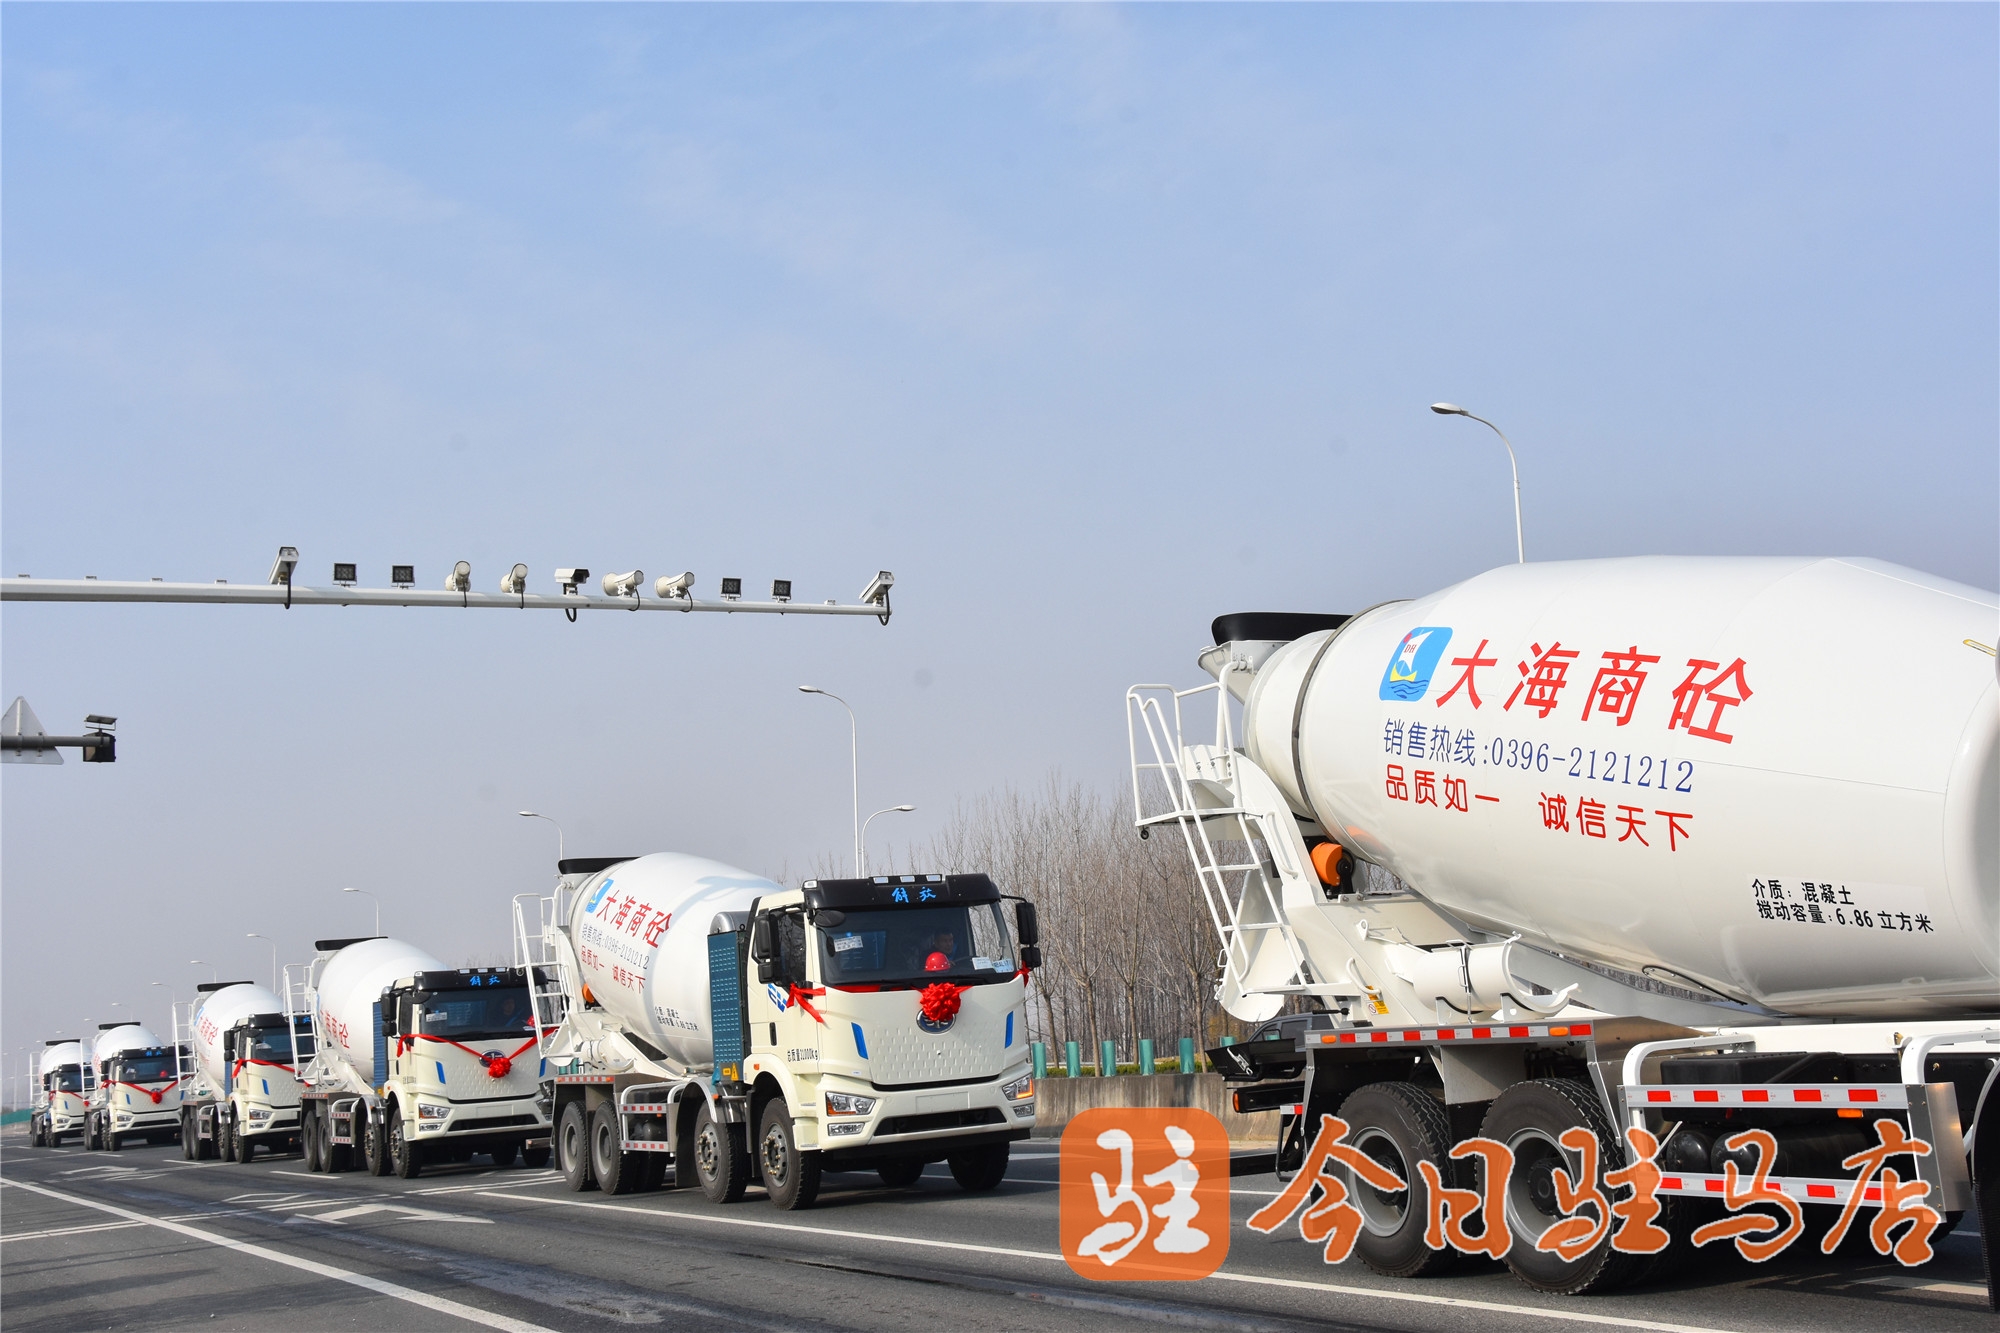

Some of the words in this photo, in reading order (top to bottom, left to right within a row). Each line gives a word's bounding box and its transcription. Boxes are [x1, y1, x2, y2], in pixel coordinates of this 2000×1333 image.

[1403, 643, 1417, 653] DH
[1436, 639, 1754, 744] 大海商砼
[1383, 718, 1694, 793] 销售热线:0396-2121212
[1385, 764, 1500, 812] 品质如一
[1538, 792, 1694, 852] 诚信天下
[596, 889, 672, 949] 大海商砼
[892, 886, 937, 903] 解放
[612, 963, 646, 994] 诚信天下
